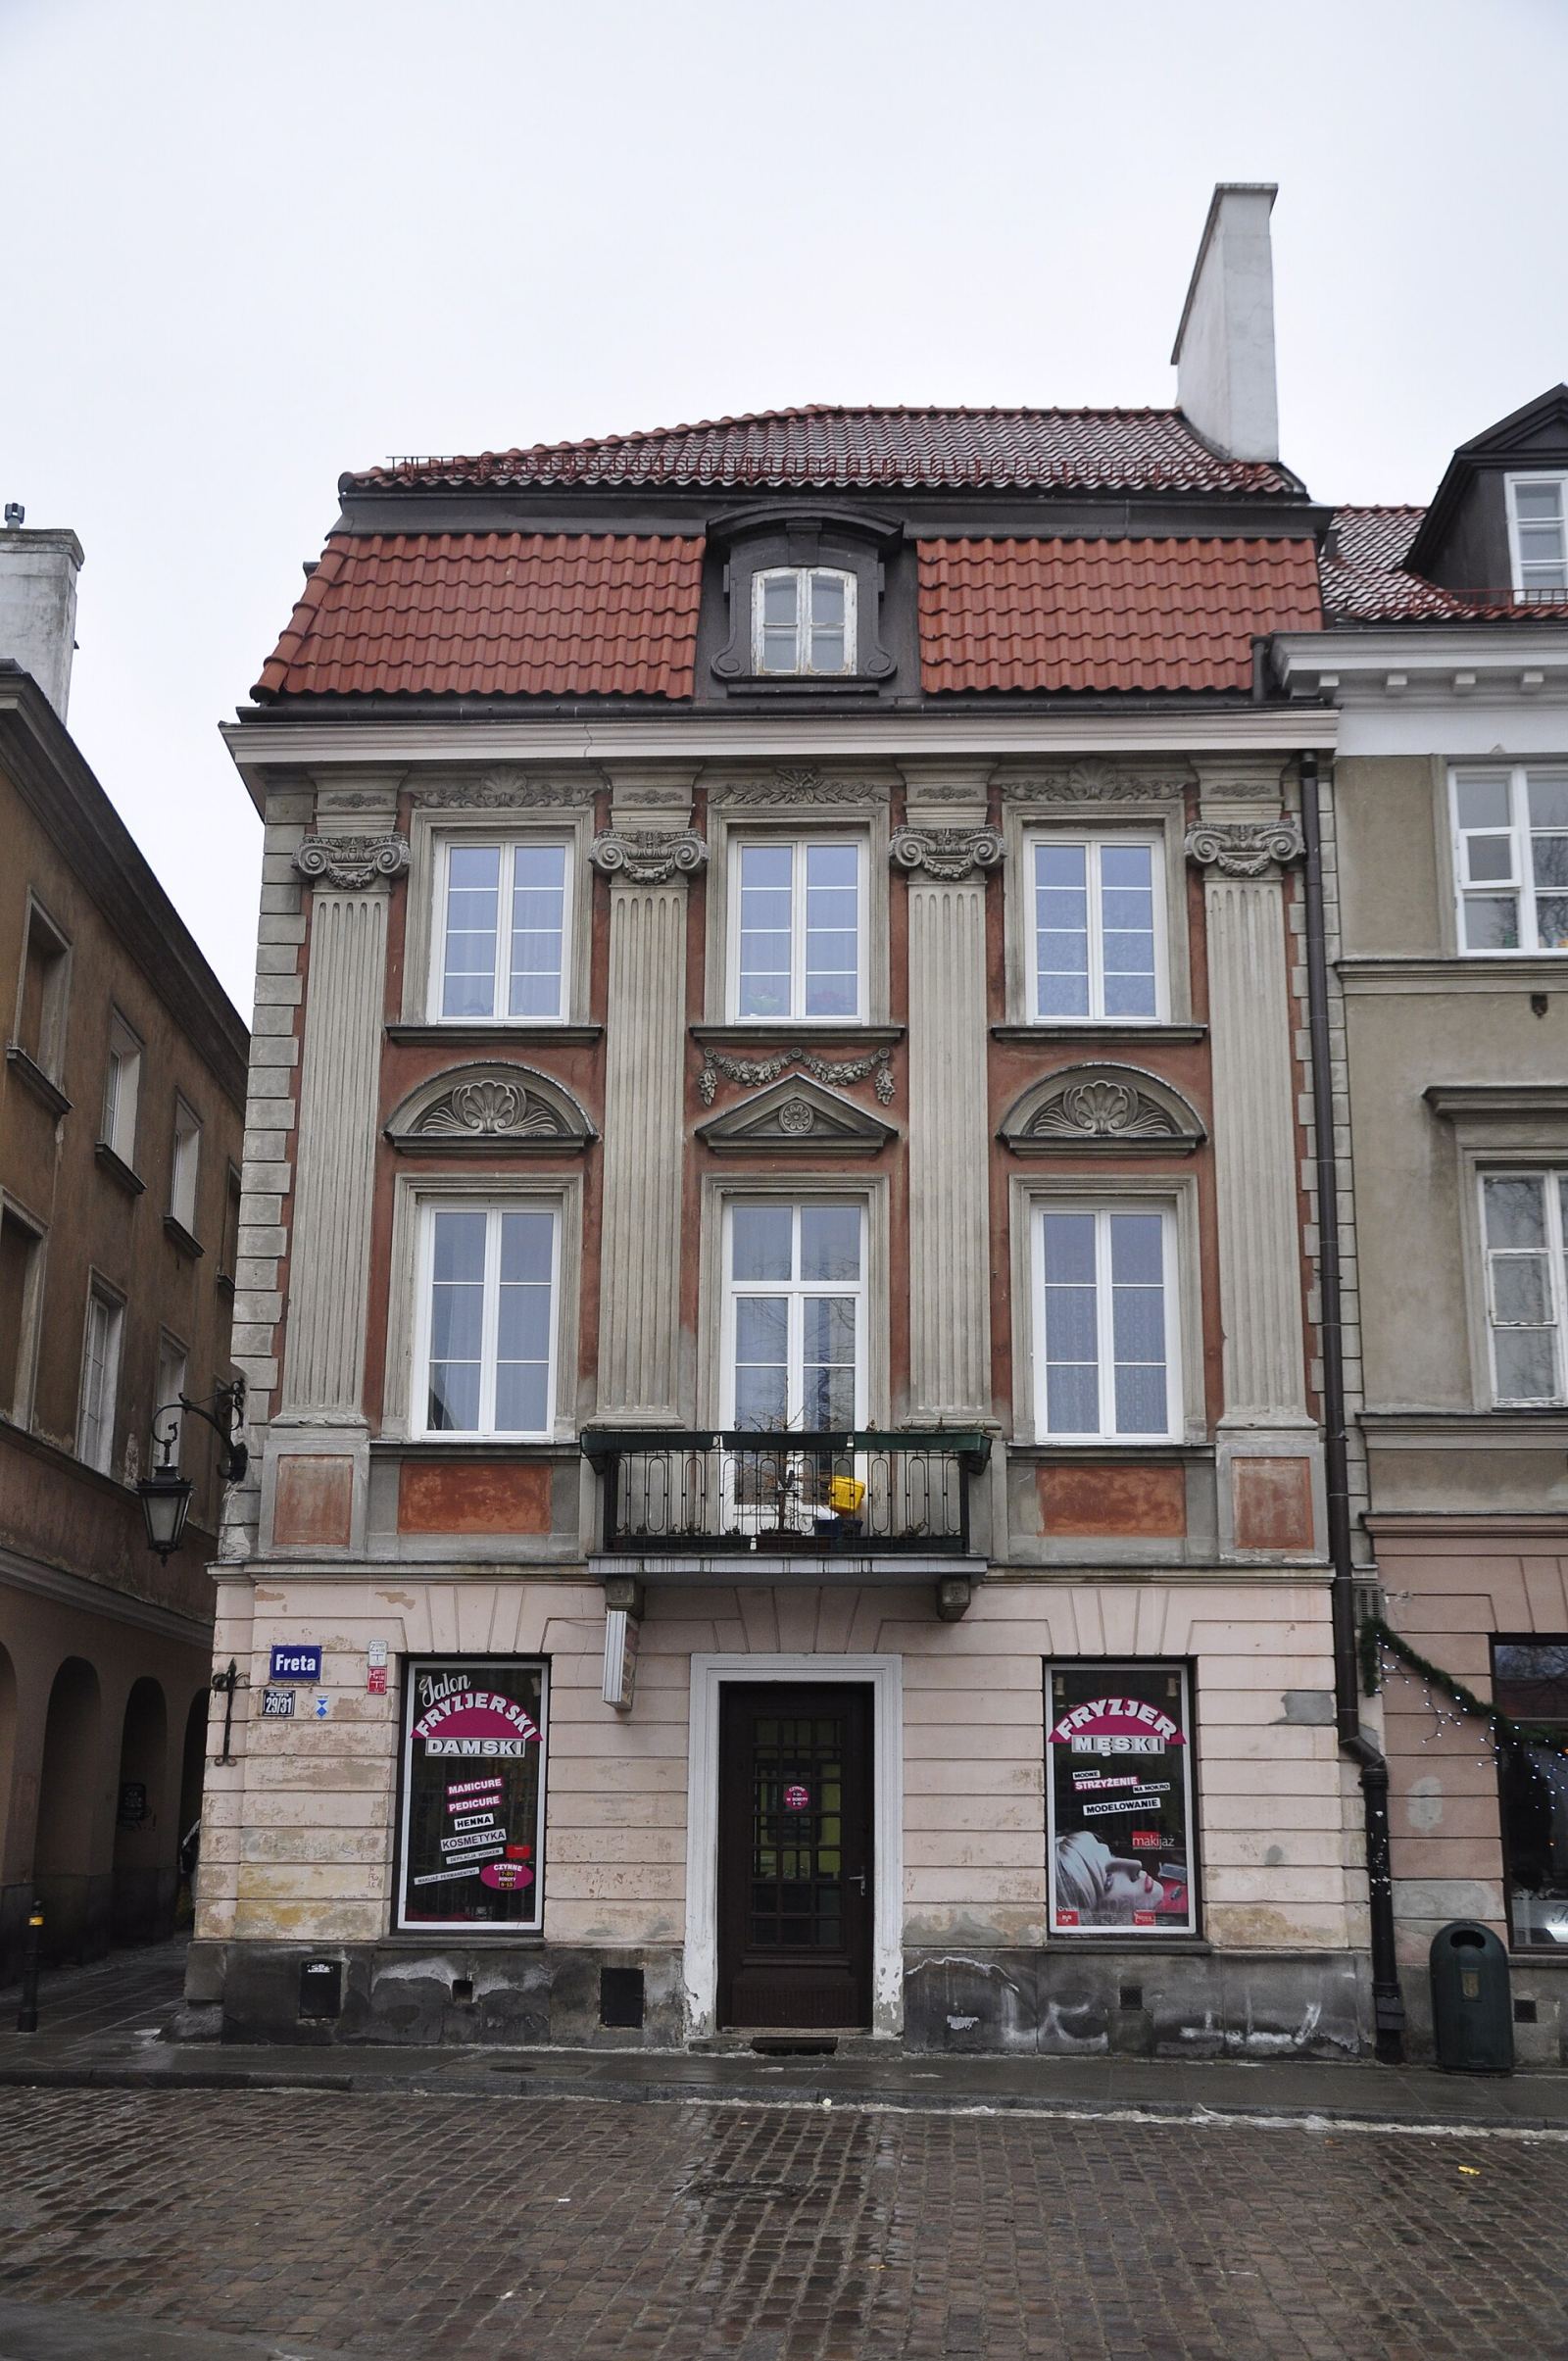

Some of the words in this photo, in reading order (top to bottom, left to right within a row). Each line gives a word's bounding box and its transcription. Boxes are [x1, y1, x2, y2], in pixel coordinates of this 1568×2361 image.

[275, 1653, 316, 1671] Freta
[418, 1672, 470, 1707] Salon
[266, 1697, 292, 1714] 29/31
[415, 1693, 537, 1739] FRYZJERSKI
[1055, 1698, 1177, 1741] FRYZJER
[427, 1740, 522, 1755] DAMSKI
[1076, 1737, 1160, 1757] MĘSKI
[448, 1778, 503, 1795] MANICURE
[1075, 1777, 1138, 1790] STRZYŻENIE
[449, 1795, 500, 1812] PEDICURE
[1086, 1799, 1158, 1814] MODELOWANIE
[457, 1816, 491, 1829] HENNA
[442, 1831, 506, 1848] KOSMETYKA
[1132, 1834, 1175, 1850] makijaż
[493, 1863, 523, 1872] CZYNNE
